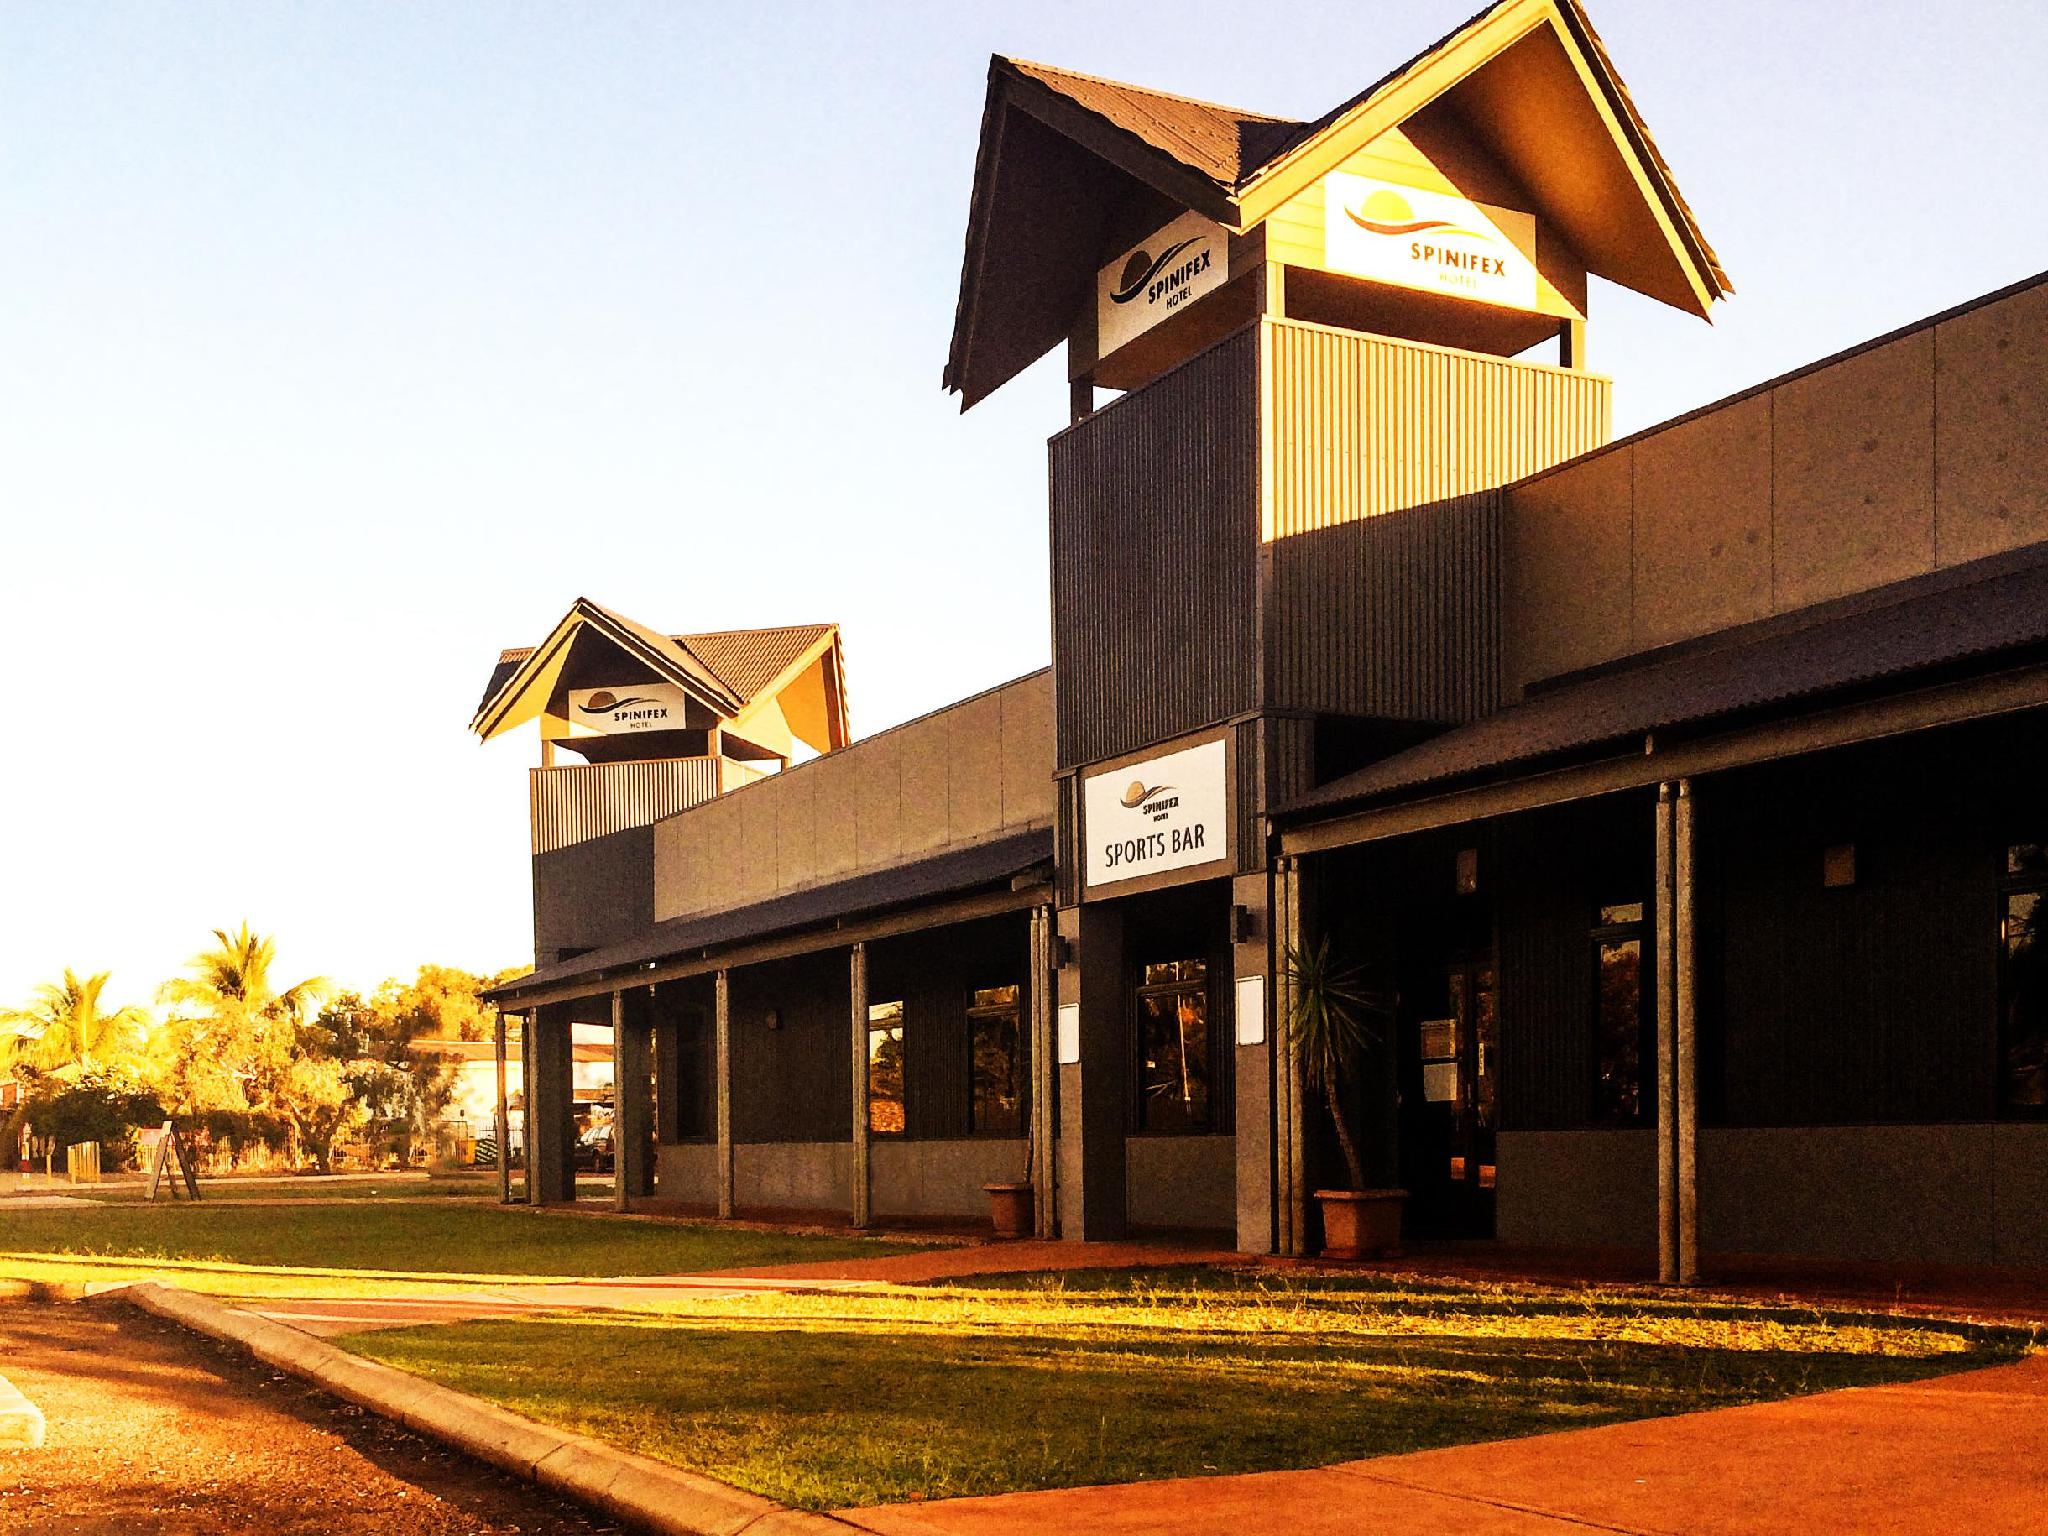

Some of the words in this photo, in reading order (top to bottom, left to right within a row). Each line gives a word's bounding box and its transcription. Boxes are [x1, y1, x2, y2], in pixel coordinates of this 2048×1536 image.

[1410, 241, 1507, 278] SPINIFEX
[1148, 248, 1211, 305] SPINIFEX
[1438, 271, 1479, 290] HOTEL
[1166, 287, 1193, 311] HOTEL
[614, 708, 668, 722] SPINIFEX
[1142, 796, 1179, 815] SPINIFEX
[1105, 832, 1165, 868] SPORTS
[1172, 823, 1205, 853] BAR
